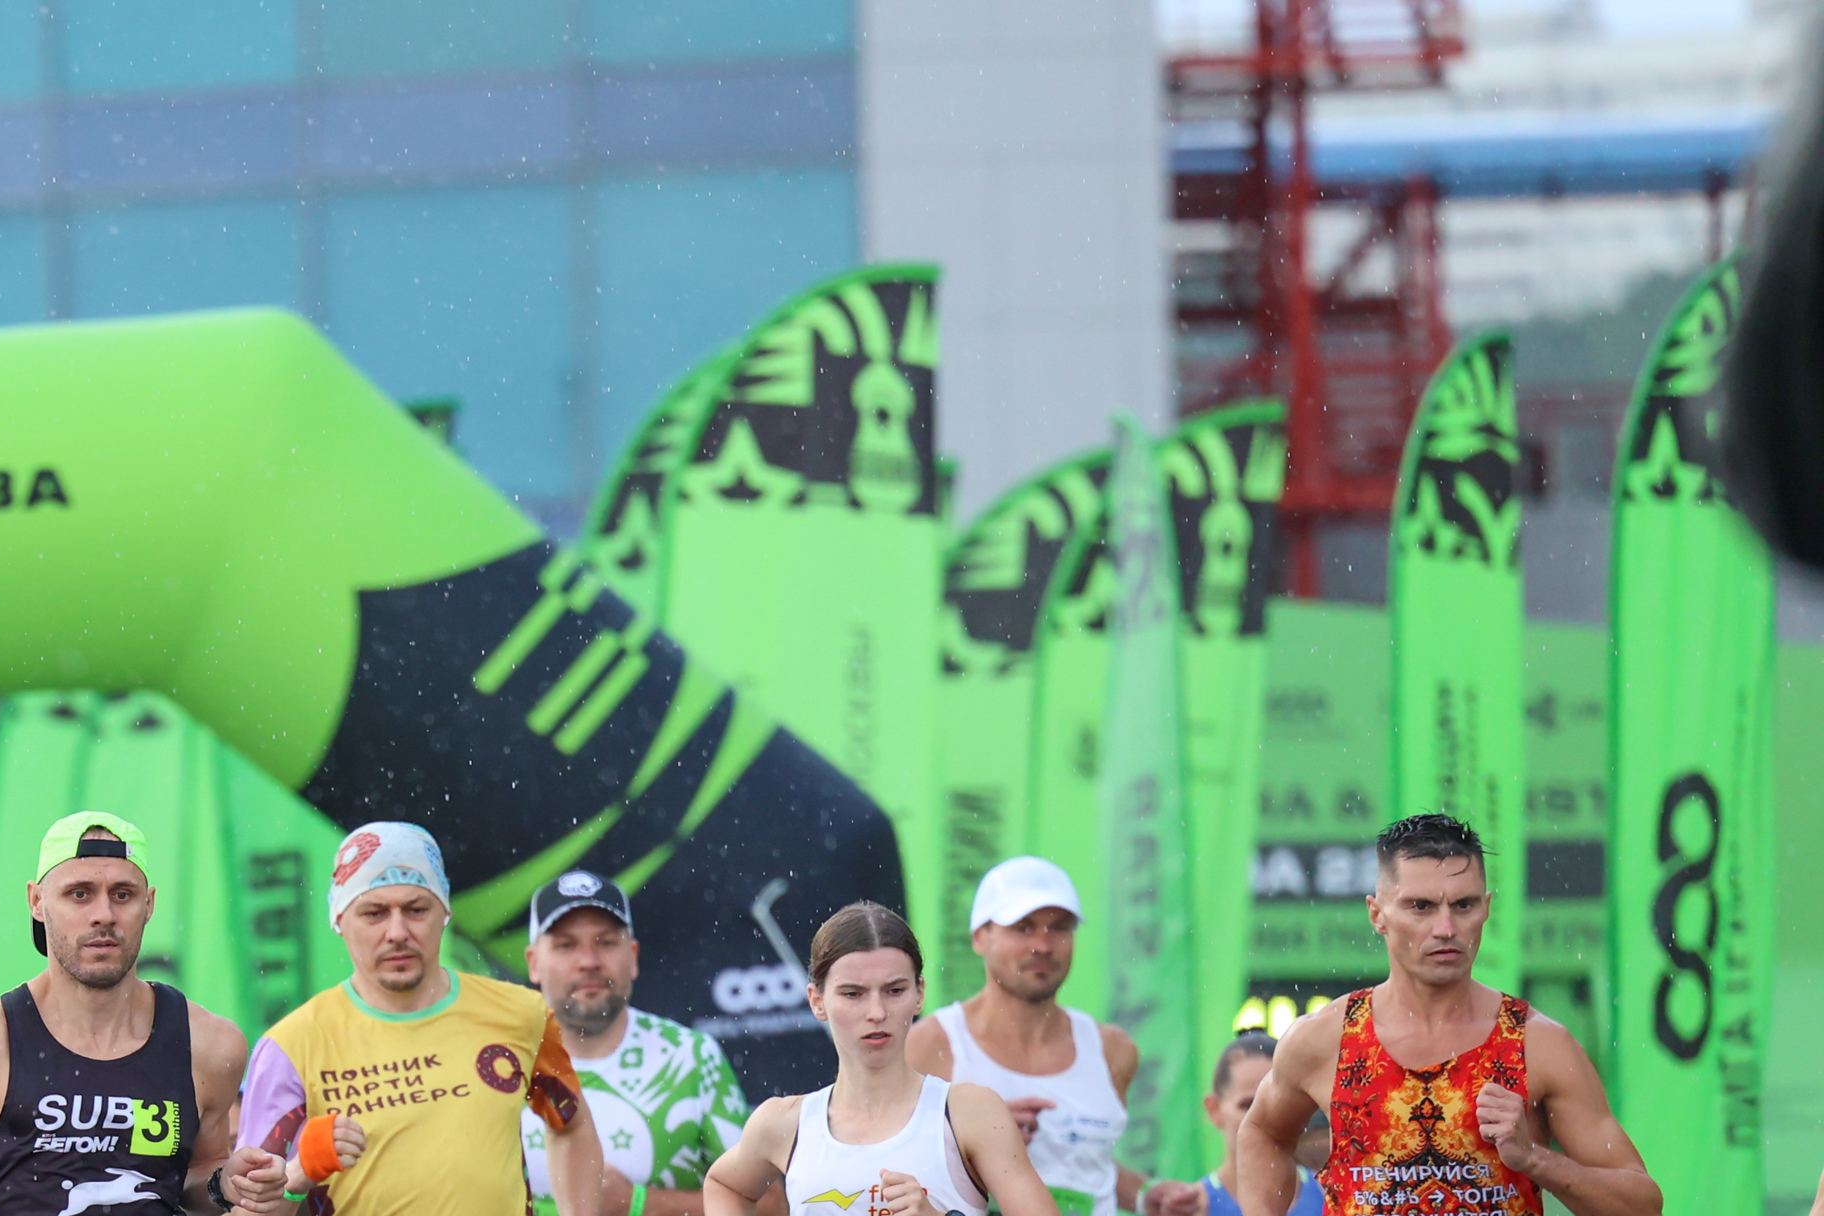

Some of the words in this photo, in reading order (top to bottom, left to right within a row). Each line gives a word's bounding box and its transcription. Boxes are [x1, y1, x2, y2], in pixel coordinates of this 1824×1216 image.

[320, 1054, 442, 1085] ПОНЧИК
[323, 1075, 424, 1102] ПАРТИ
[33, 1136, 119, 1154] БЕГОМ!
[1452, 1183, 1519, 1205] ТОГДА
